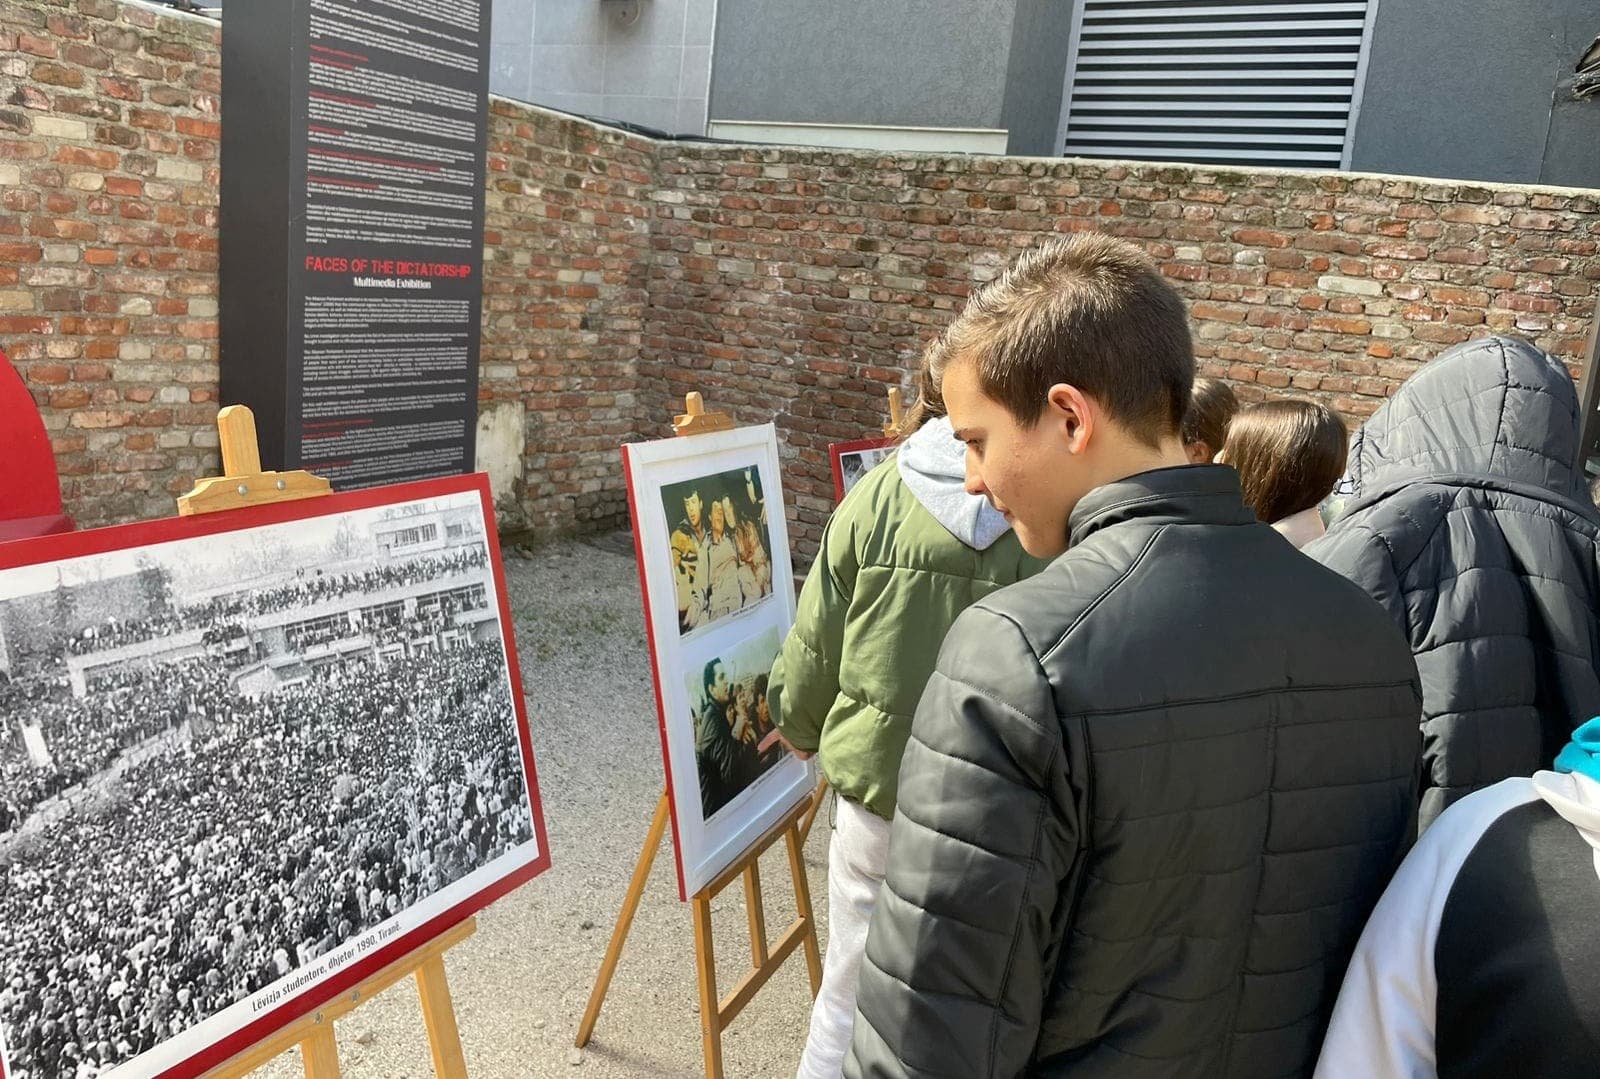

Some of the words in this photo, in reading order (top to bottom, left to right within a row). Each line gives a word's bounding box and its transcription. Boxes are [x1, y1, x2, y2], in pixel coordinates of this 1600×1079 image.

[305, 256, 348, 272] FACES
[351, 259, 368, 273] OF
[372, 260, 394, 275] THE
[397, 262, 471, 278] DICTATORSHIP
[354, 277, 396, 289] Multimedia
[397, 279, 432, 290] Exhibition
[252, 990, 281, 1012] Lëvizja
[282, 966, 328, 996] studentore,
[328, 949, 355, 970] dhjetor
